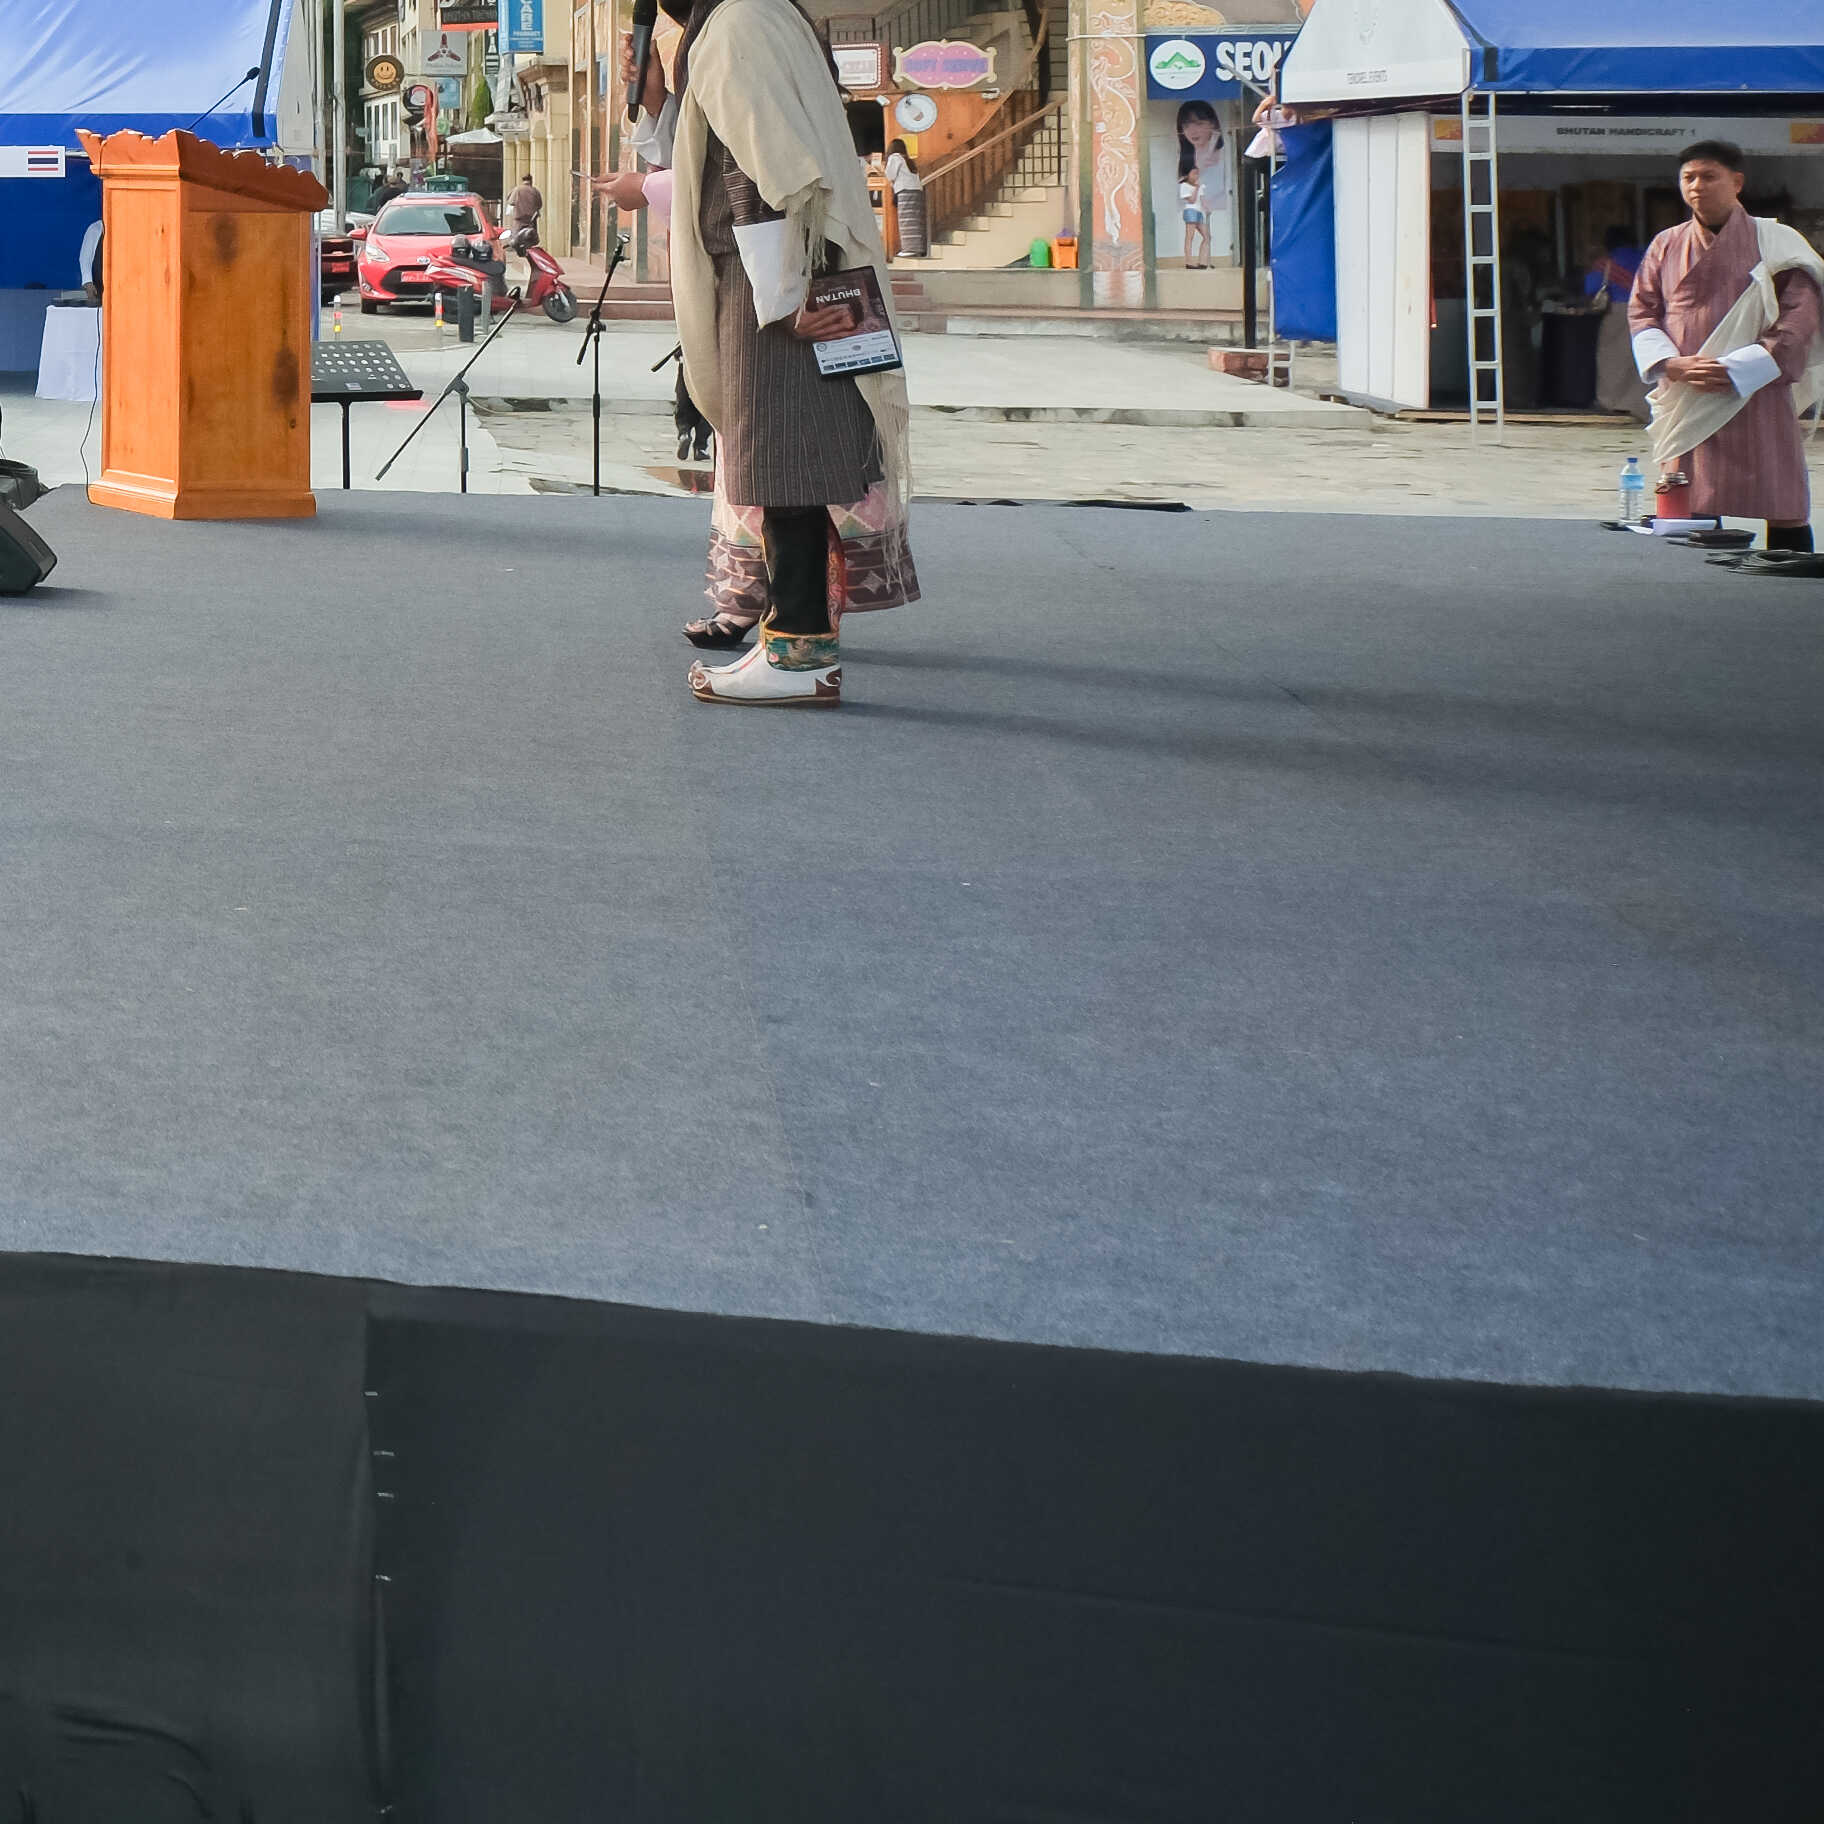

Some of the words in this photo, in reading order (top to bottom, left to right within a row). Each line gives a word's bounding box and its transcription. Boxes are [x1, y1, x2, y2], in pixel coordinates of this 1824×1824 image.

[1556, 127, 1606, 136] BHUTAN
[1608, 127, 1686, 137] HANDICRAFT
[815, 288, 861, 304] BHUTAN
